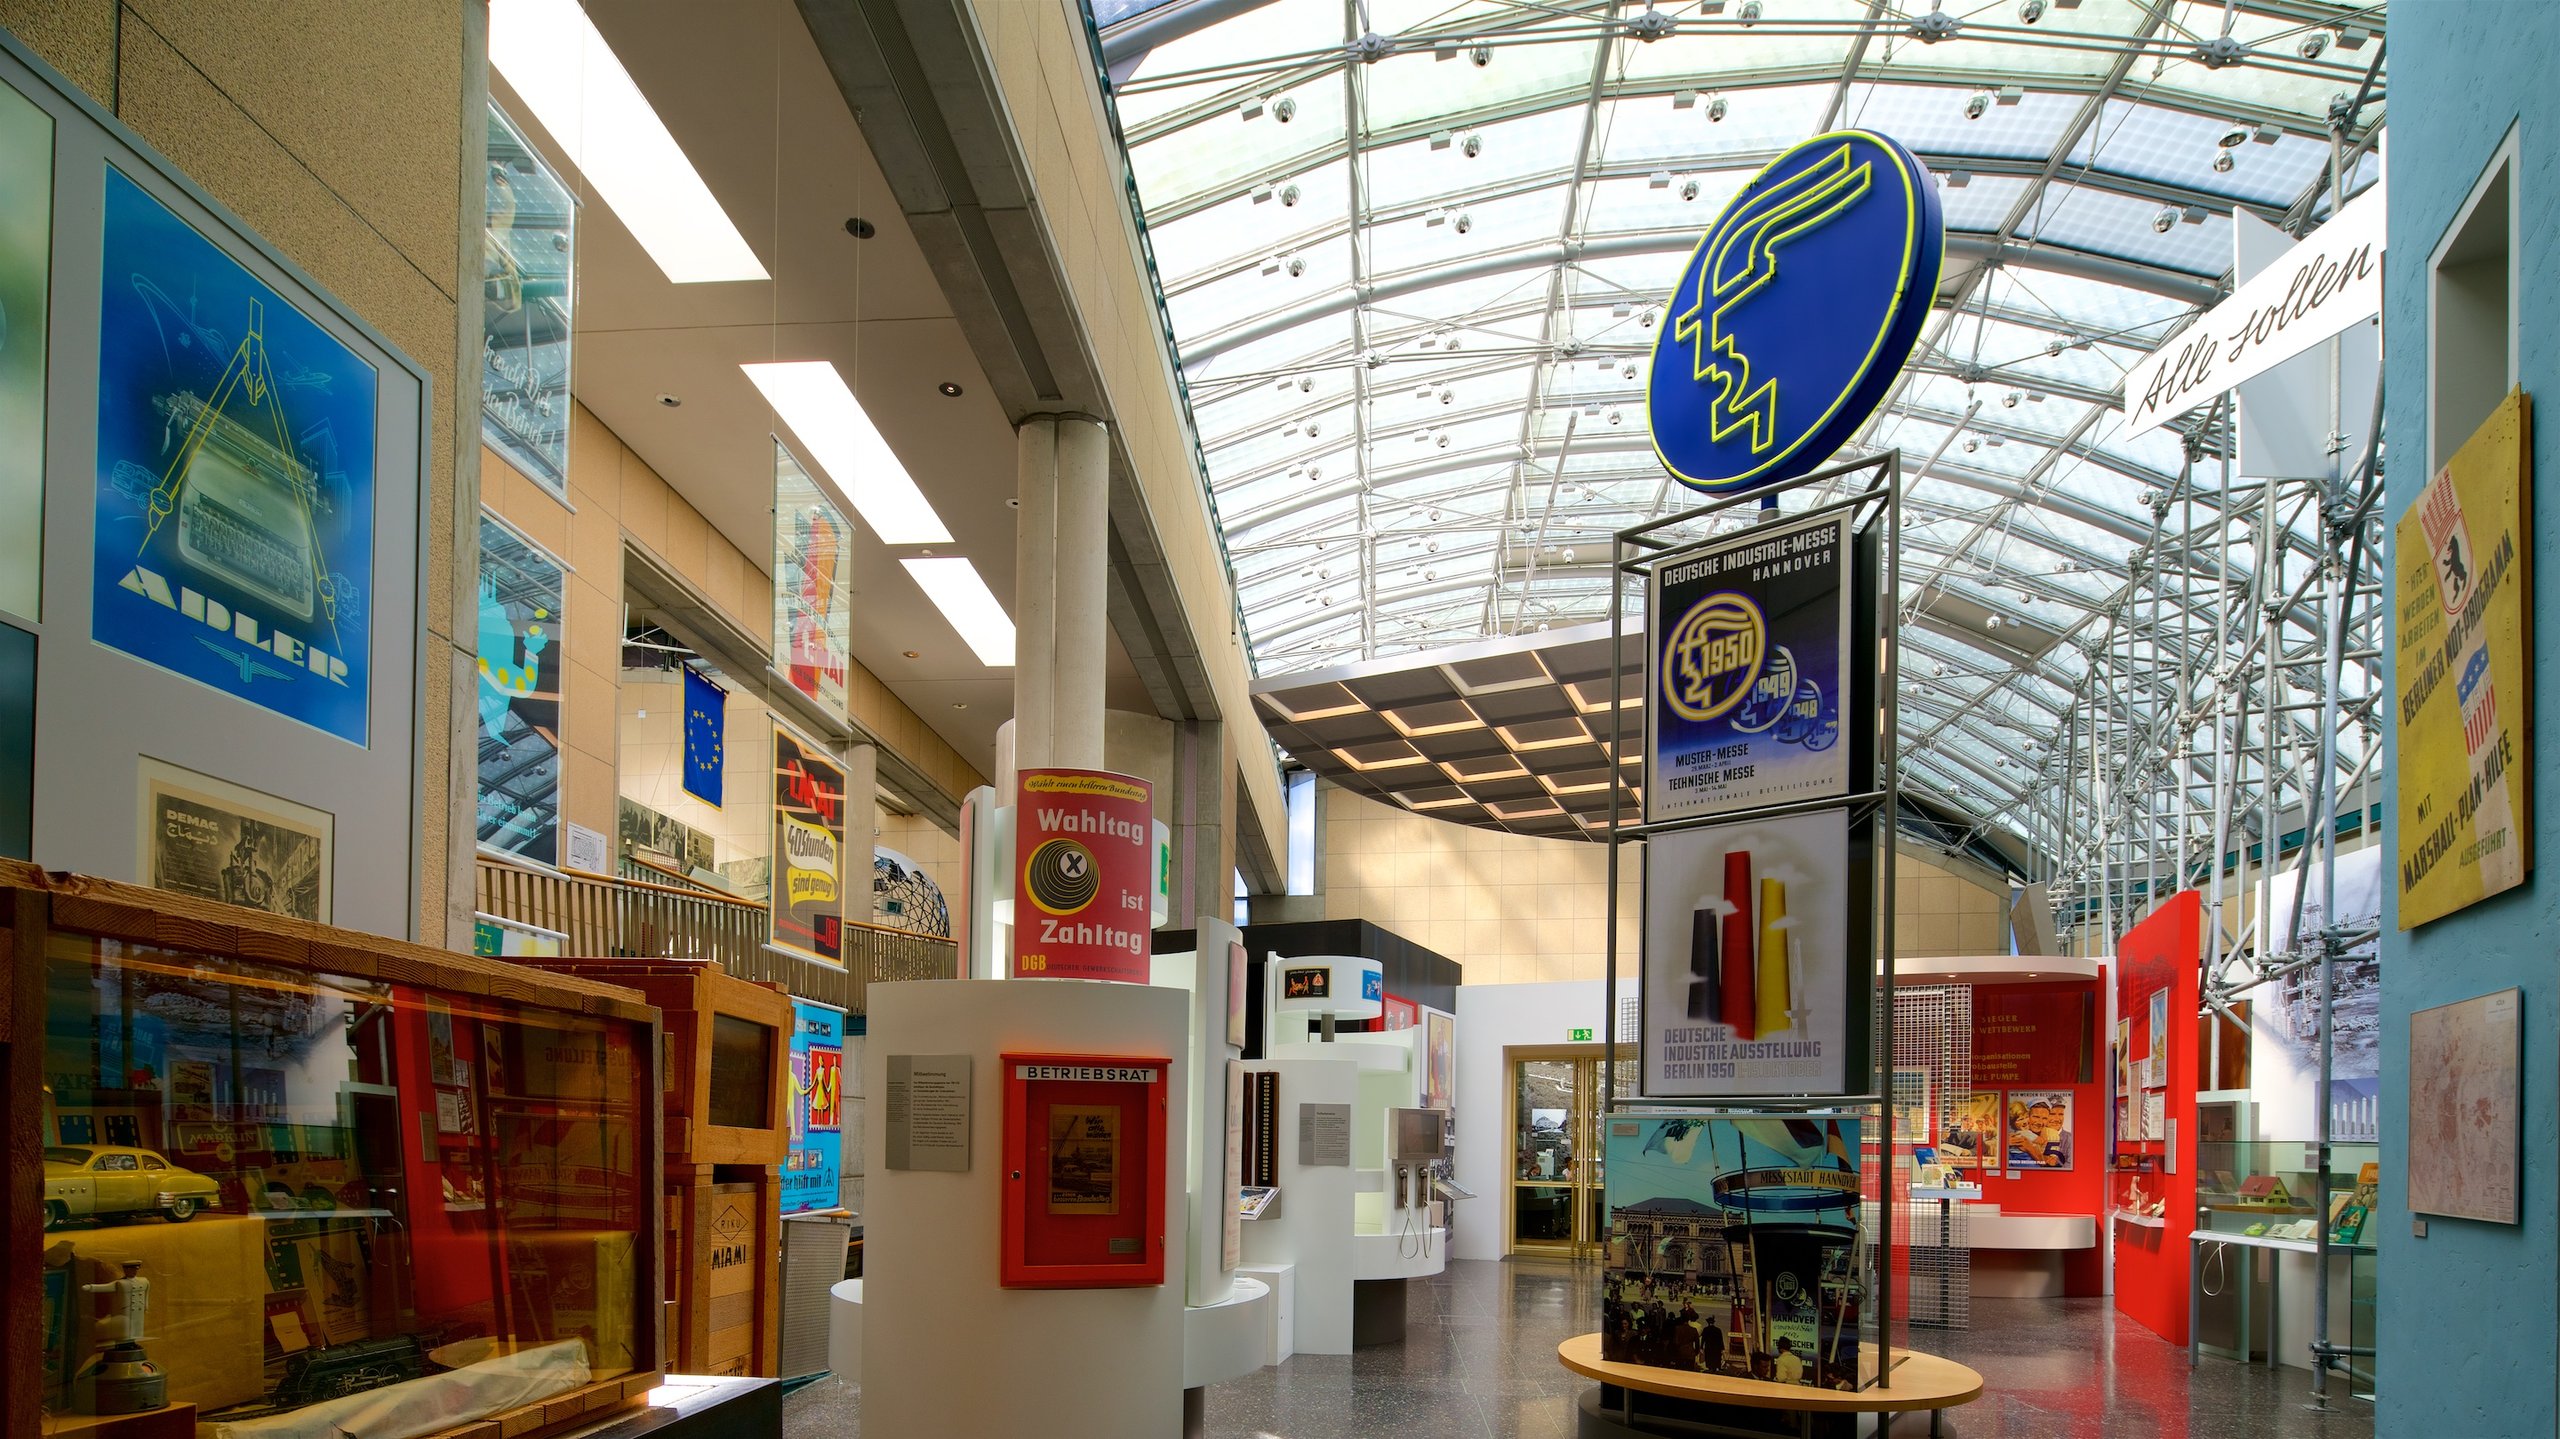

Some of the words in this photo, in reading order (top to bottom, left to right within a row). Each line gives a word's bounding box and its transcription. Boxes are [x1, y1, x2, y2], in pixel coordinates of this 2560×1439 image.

[2131, 332, 2219, 426] Alle
[2228, 242, 2374, 364] sollen
[1664, 557, 1719, 587] DEUTSCHE
[1723, 526, 1836, 572] INDUSTRIE-MESSE
[1753, 550, 1831, 582] HANNOVER
[2410, 562, 2428, 593] HIER
[2403, 583, 2435, 625] WERDEN
[118, 564, 350, 689] ADLER
[2401, 607, 2440, 652] ARBEITEN
[1701, 628, 1754, 679] 1950
[2415, 645, 2427, 669] IM
[1752, 670, 1791, 704] 1949
[2402, 647, 2445, 728] BERLINER
[1675, 743, 1749, 768] MUSTER-MESSE
[1669, 770, 1719, 791] TECHNISCHE
[1723, 765, 1755, 782] MESSE
[166, 809, 219, 832] DEMAG
[2418, 793, 2432, 824] MIT
[1037, 808, 1144, 846] Wahltag
[2458, 827, 2507, 870] AUSGEFÜHRT
[793, 872, 811, 894] sind
[810, 876, 833, 898] genug
[1121, 889, 1144, 911] ist
[1040, 919, 1142, 955] Zahltag
[1021, 954, 1046, 971] DGB
[1664, 1027, 1726, 1044] DEUTSCHE
[1664, 1044, 1727, 1061] INDUSTRIE
[1730, 1041, 1821, 1060] AUSSTELLUNG
[1027, 1066, 1150, 1081] BETRIEBSRAT
[1664, 1063, 1705, 1079] BERLIN
[1706, 1062, 1735, 1078] 1950
[1990, 1072, 2020, 1081] PUMPE
[1760, 1170, 1814, 1184] MESSESTADT
[1819, 1170, 1856, 1188] HANNOVER
[711, 1244, 747, 1270] MIAMI
[1772, 1314, 1815, 1324] HANNOVER
